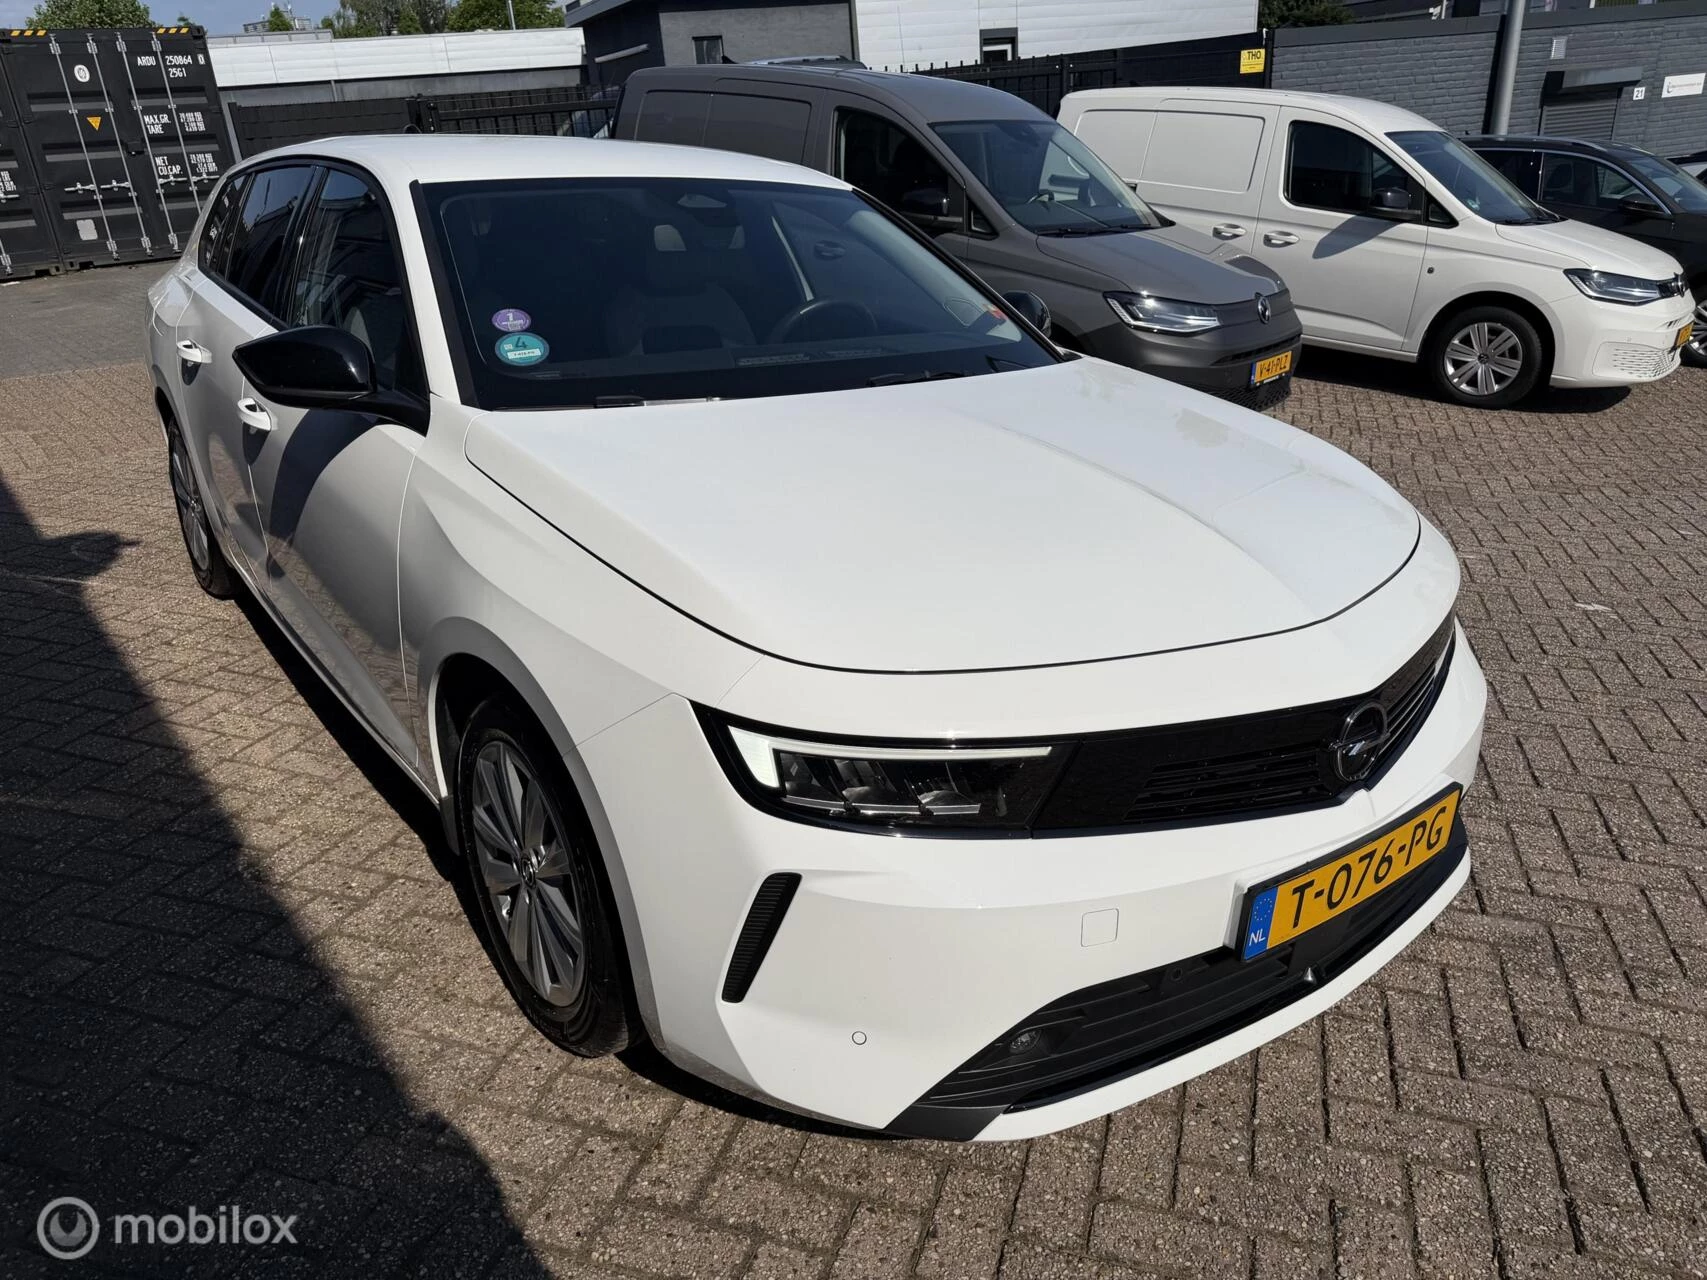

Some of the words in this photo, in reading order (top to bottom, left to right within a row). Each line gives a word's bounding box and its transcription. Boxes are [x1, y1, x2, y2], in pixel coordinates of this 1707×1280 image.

[137, 56, 156, 66] ARDU
[165, 55, 192, 65] 250864
[168, 68, 187, 77] 25G1
[1635, 89, 1644, 98] 21
[147, 124, 164, 134] TARE
[155, 156, 168, 166] NET
[515, 336, 528, 348] 4
[1291, 805, 1447, 929] T-076-PG
[1249, 928, 1266, 946] NL
